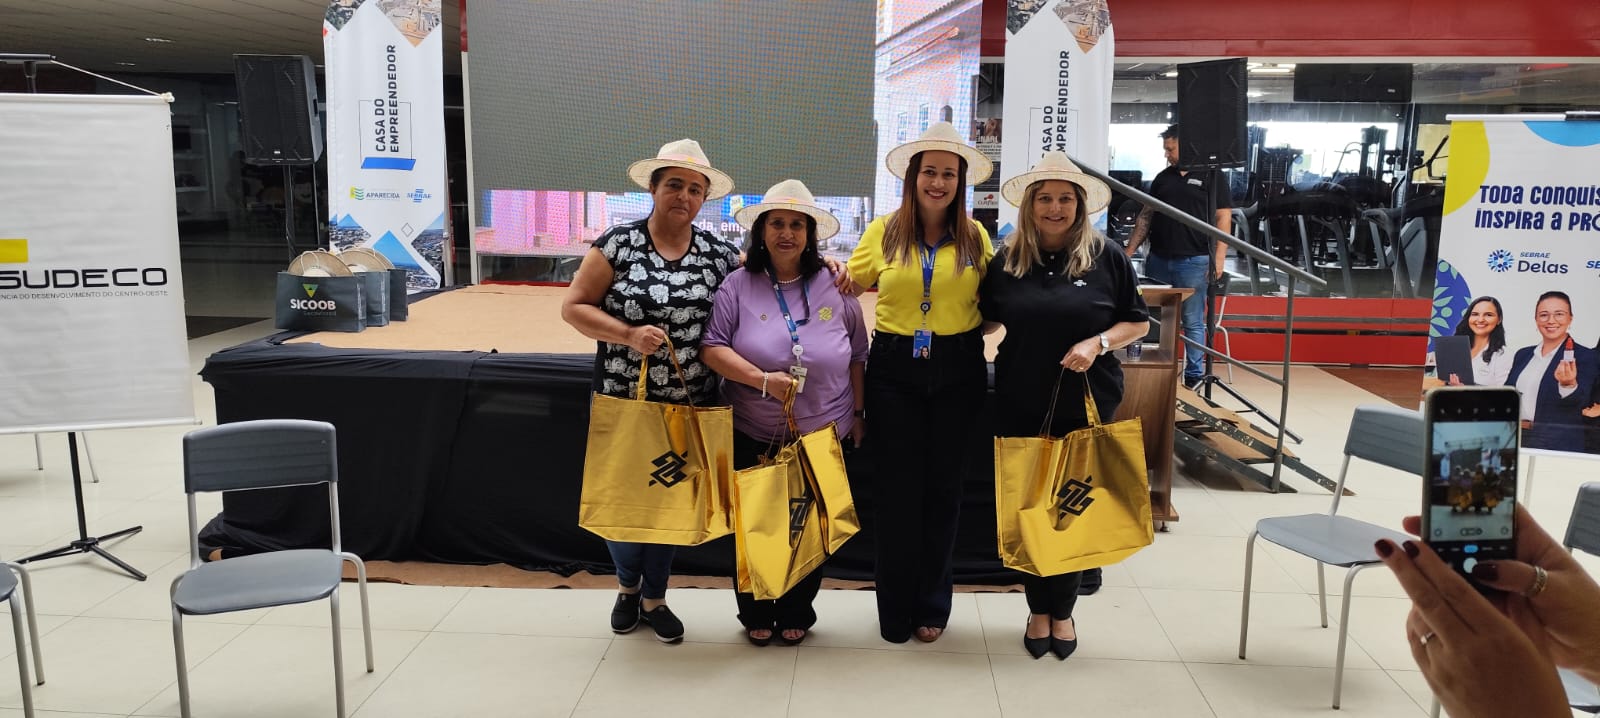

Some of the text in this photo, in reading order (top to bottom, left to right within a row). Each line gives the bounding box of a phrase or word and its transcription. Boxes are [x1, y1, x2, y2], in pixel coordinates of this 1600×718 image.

[387, 44, 399, 152] EMPREENDEDOR
[1056, 50, 1069, 152] MPREENDEDOR
[374, 98, 386, 152] CASA DO
[1042, 105, 1053, 158] ASA DO
[0, 267, 168, 289] SUDECO
[1518, 260, 1568, 274] Delas
[32, 291, 101, 299] DESENVOLVIMENTO
[290, 298, 336, 310] SICOOB
